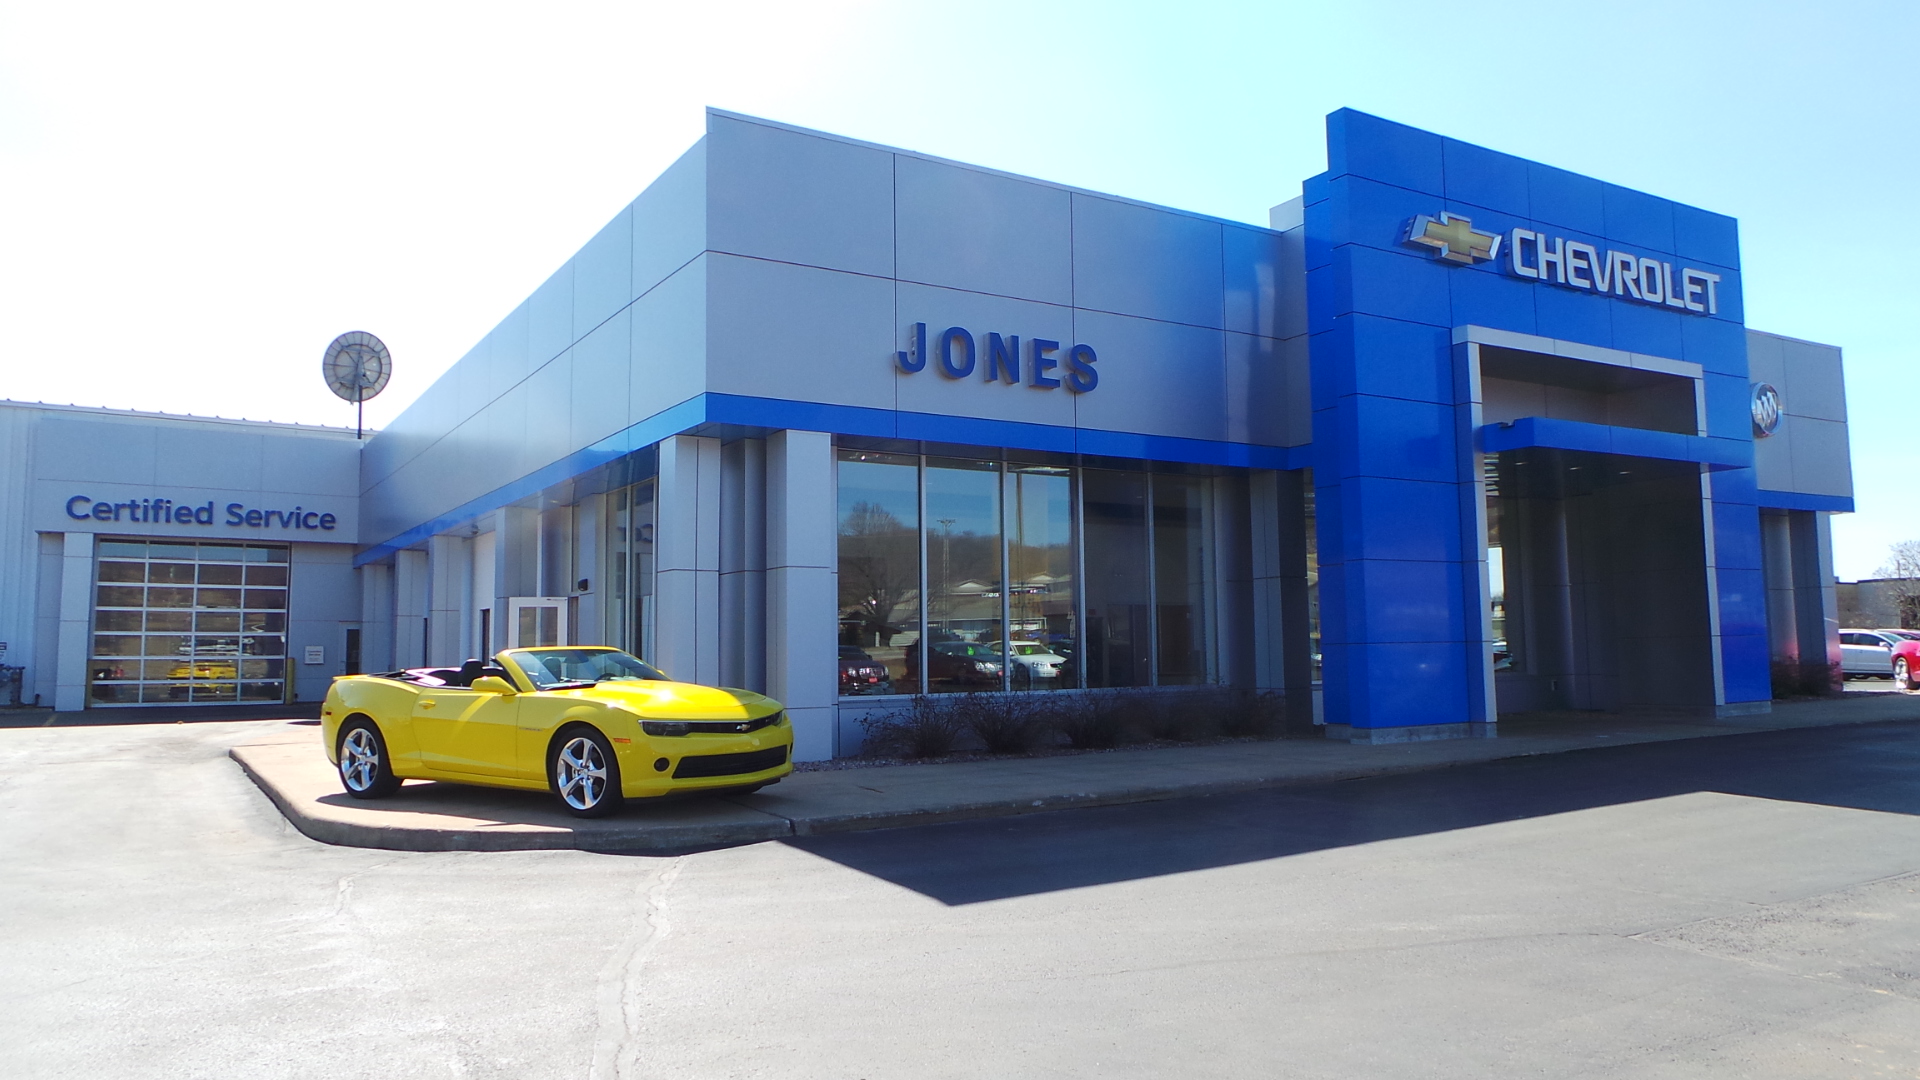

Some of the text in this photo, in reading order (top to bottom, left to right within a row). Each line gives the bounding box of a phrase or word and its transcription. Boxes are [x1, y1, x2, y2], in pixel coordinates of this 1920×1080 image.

[1511, 227, 1720, 315] CHEVROLET
[895, 322, 1098, 393] JONES
[66, 495, 336, 530] Certified Service
